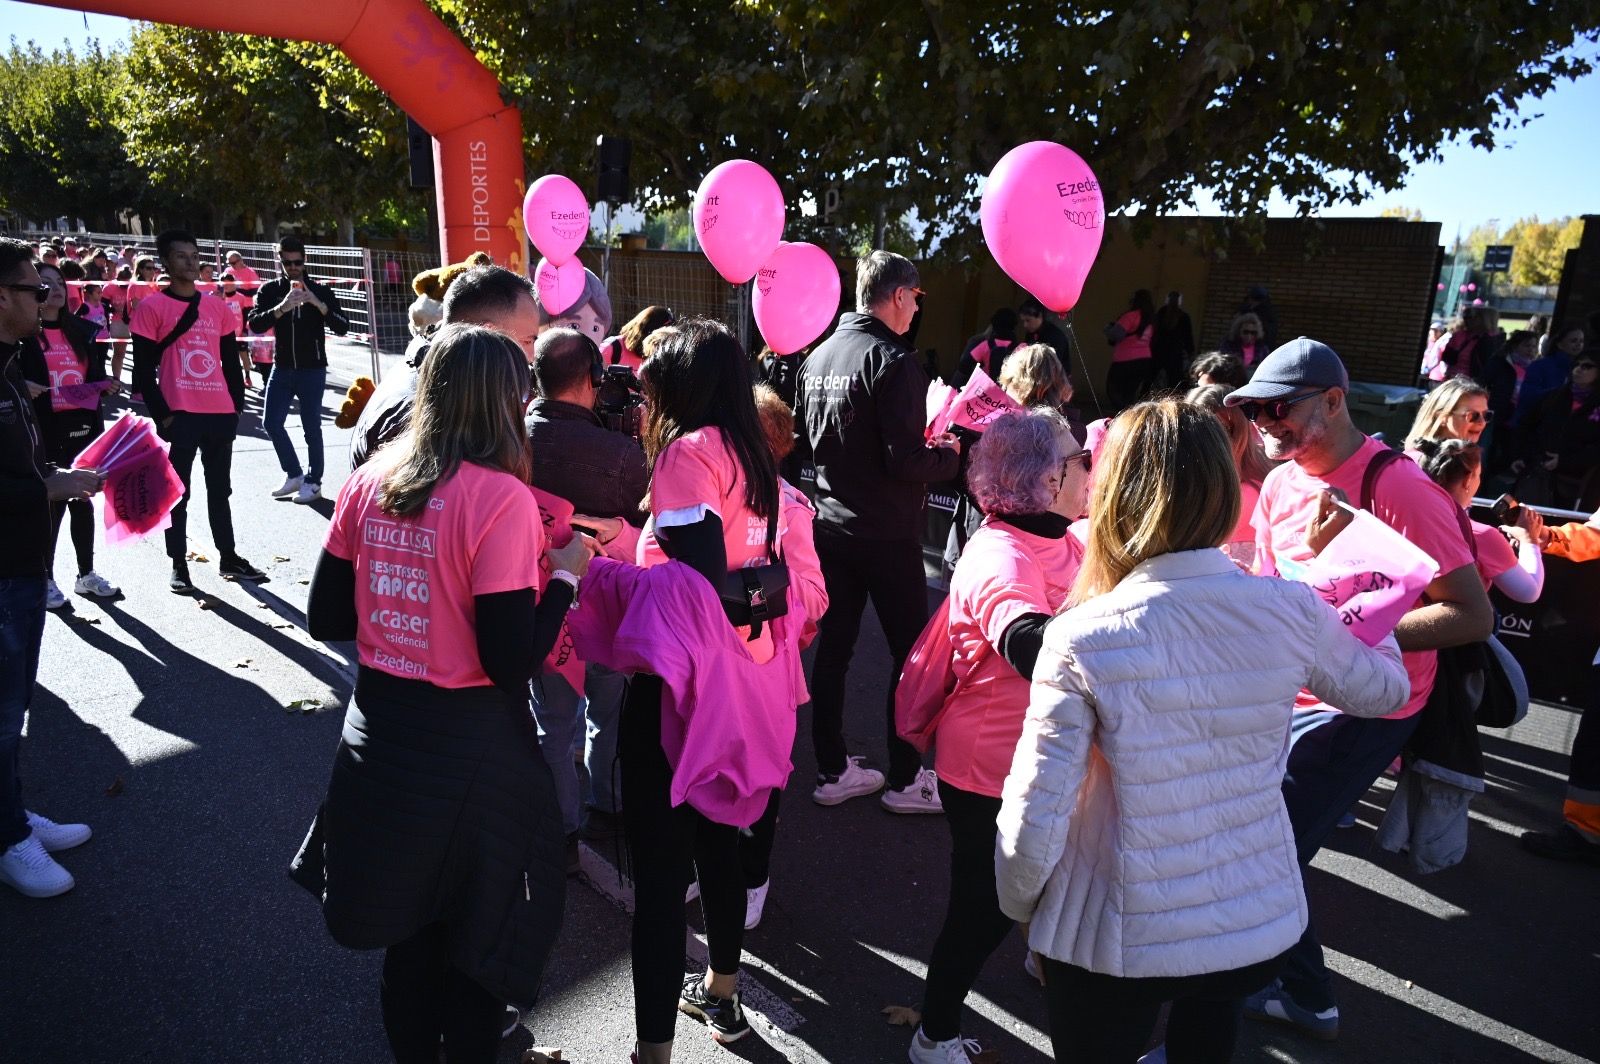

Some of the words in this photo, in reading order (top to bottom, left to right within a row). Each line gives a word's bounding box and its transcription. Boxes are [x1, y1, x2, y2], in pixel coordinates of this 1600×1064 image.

[470, 141, 491, 242] DEPORTES
[551, 211, 585, 220] Ezedent
[429, 497, 445, 510] ca
[370, 560, 429, 581] DESATASCOS
[370, 573, 430, 604] ZAPICO
[379, 609, 430, 635] caser
[374, 648, 429, 676] Ezedent
